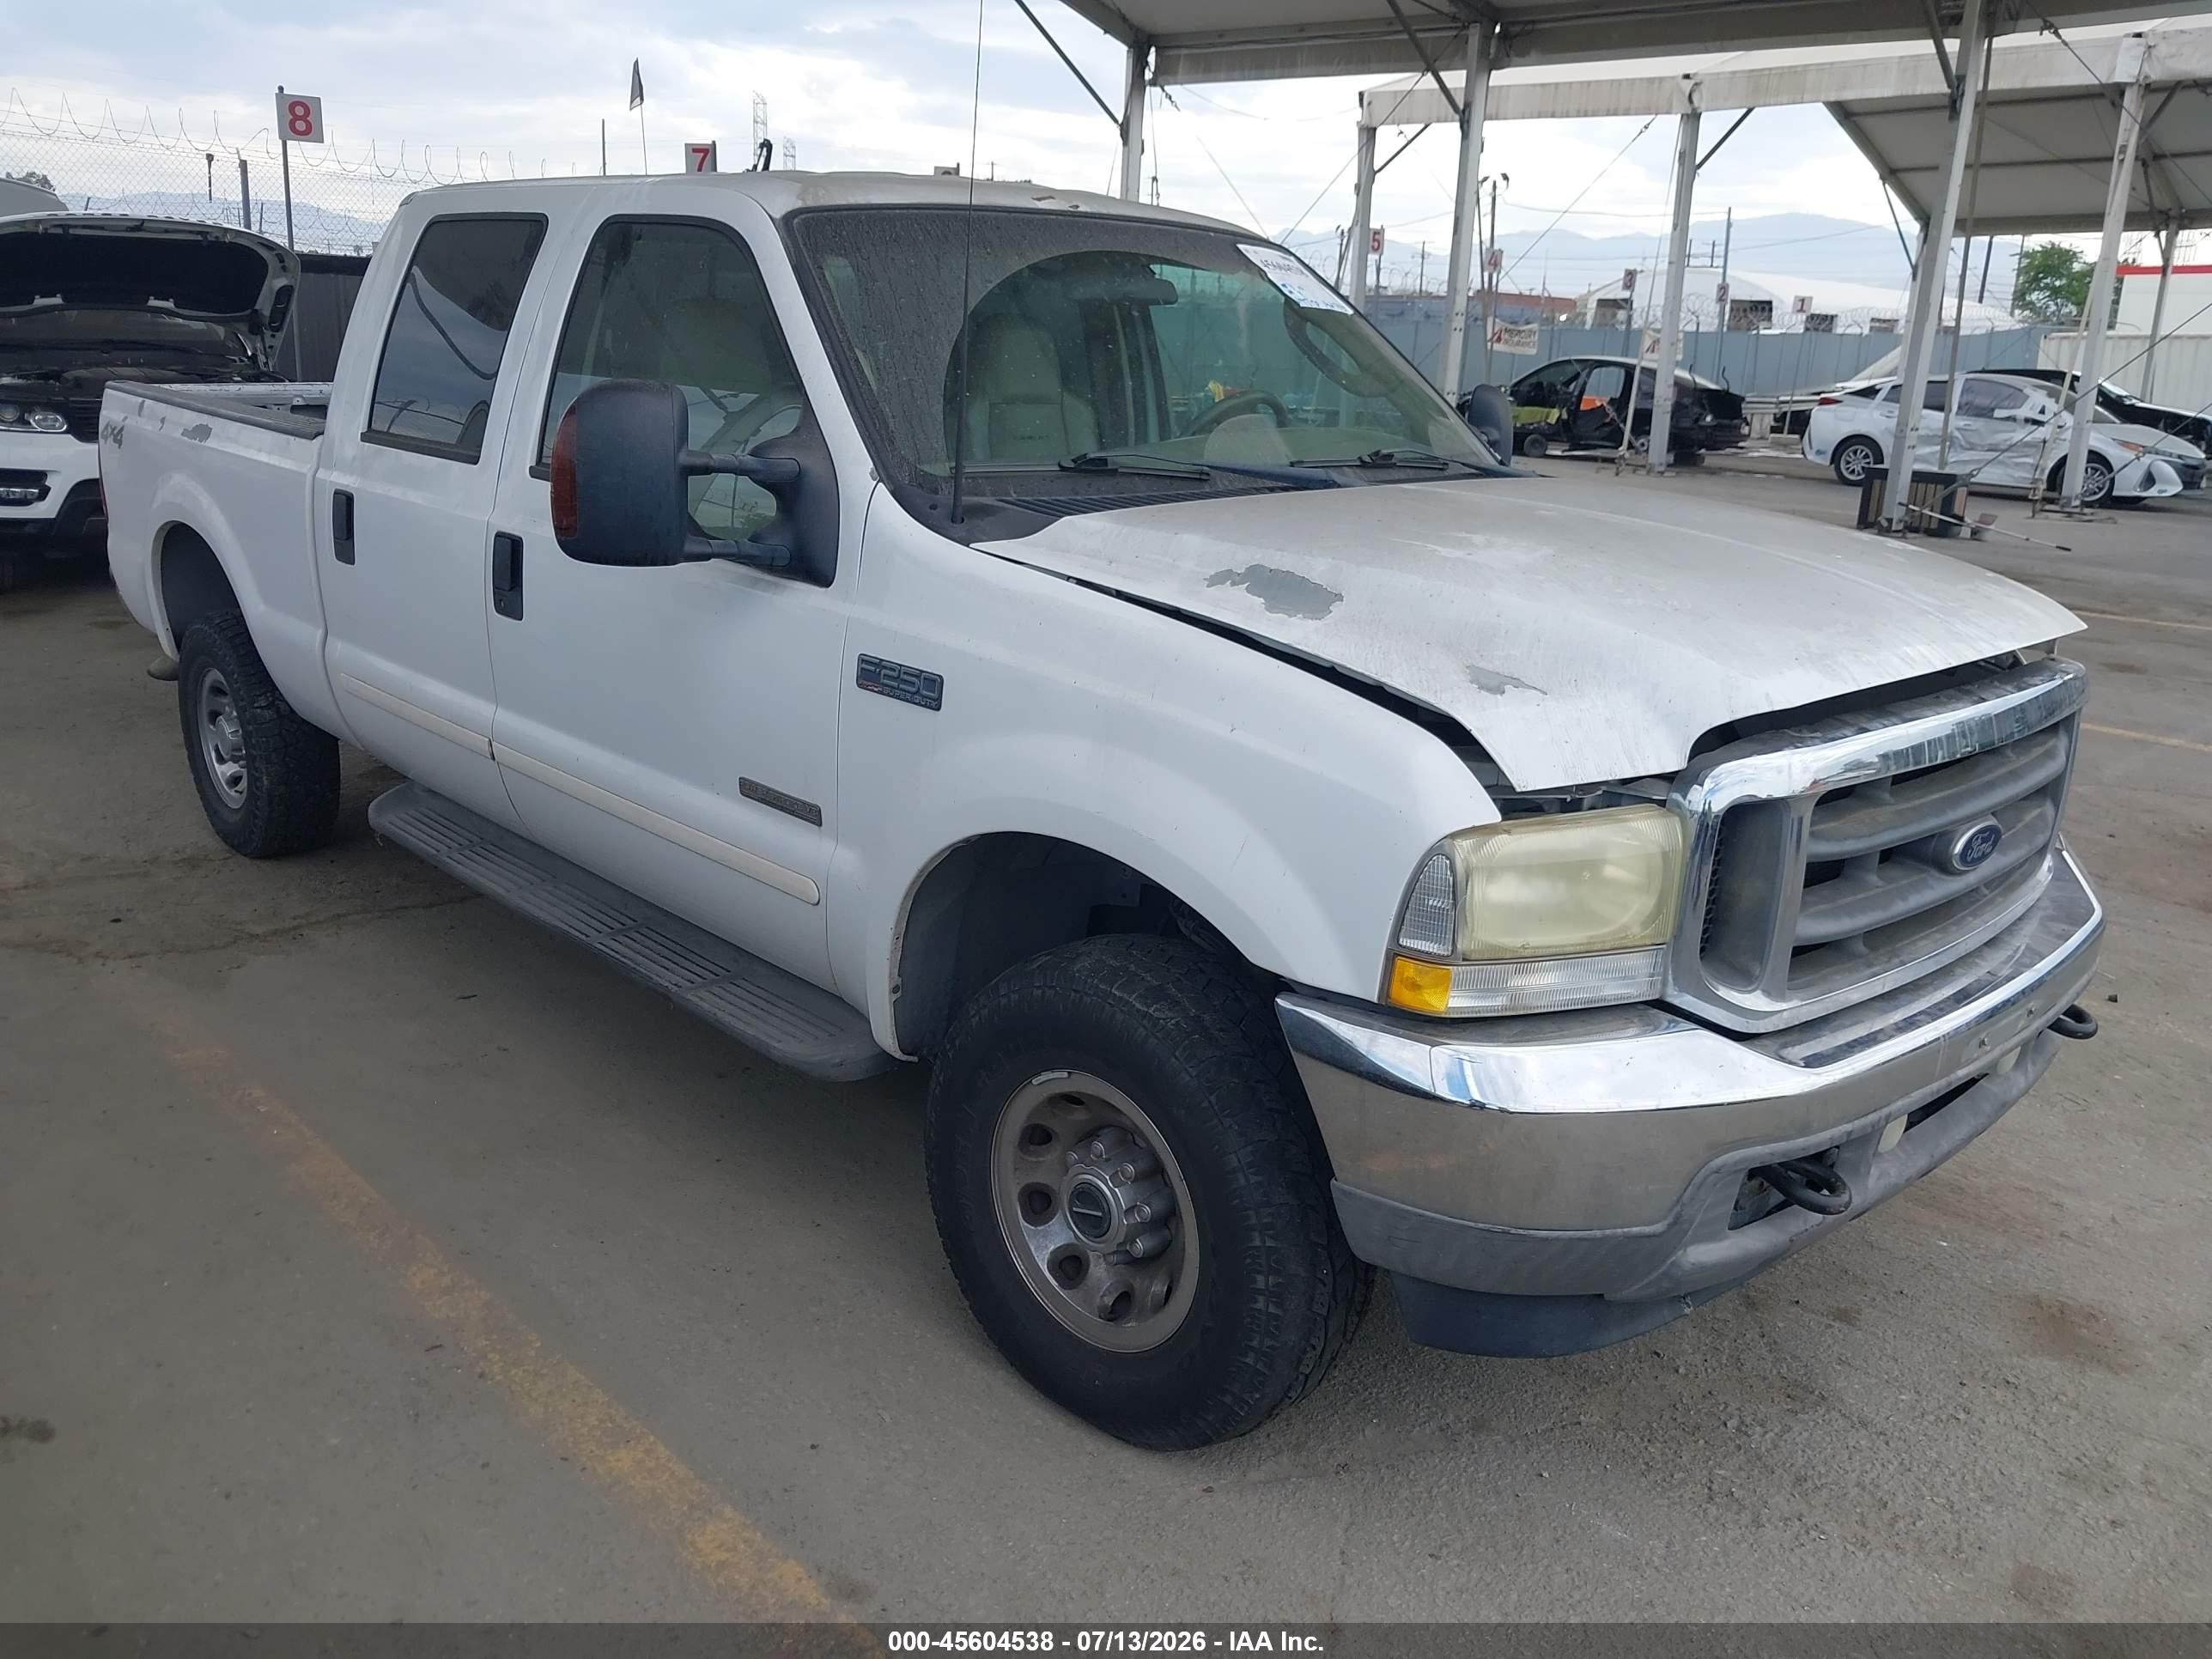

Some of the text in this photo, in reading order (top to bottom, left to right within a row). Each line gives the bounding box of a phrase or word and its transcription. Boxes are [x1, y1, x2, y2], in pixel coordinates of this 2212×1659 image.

[289, 100, 313, 136] 8
[691, 148, 710, 173] 7
[1370, 231, 1381, 252] 5
[1487, 250, 1498, 270] 4
[1624, 270, 1633, 288] 3
[1718, 286, 1726, 301] 2
[1797, 299, 1806, 313] 1
[1966, 830, 1996, 862] Ford
